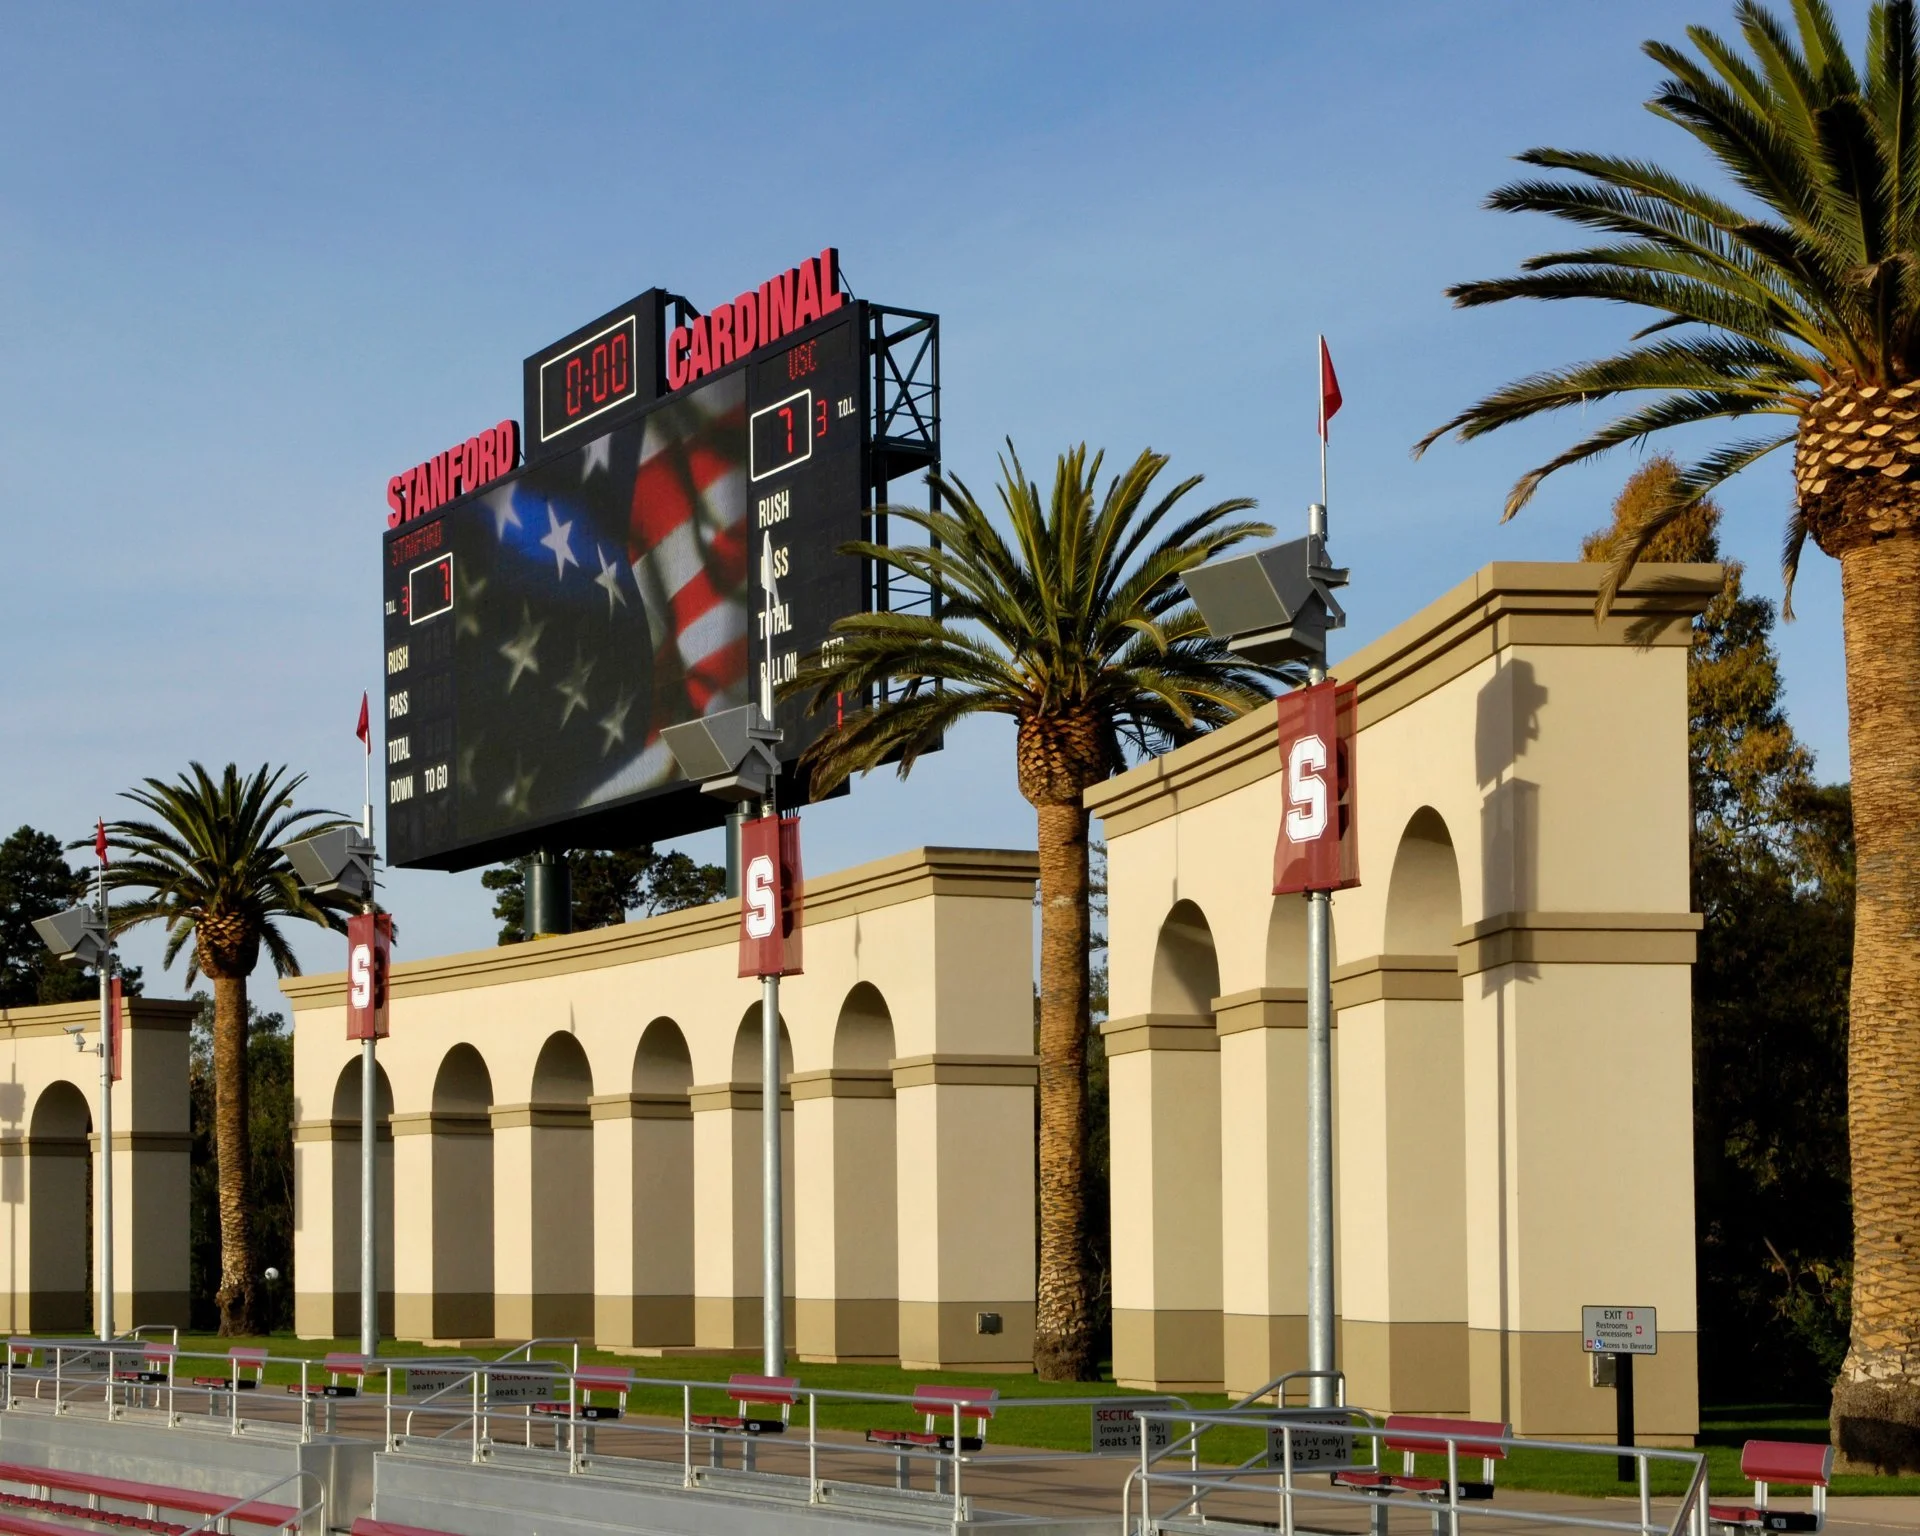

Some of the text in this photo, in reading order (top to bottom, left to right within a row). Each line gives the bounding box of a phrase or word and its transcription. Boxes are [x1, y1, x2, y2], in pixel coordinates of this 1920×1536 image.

[668, 247, 845, 392] CARDINAL
[567, 333, 627, 416] 0:00
[789, 341, 816, 380] USC
[778, 407, 792, 454] 7
[816, 400, 826, 438] 3
[387, 419, 517, 529] STANFORD
[759, 490, 790, 528] RUSH
[439, 562, 449, 600] 7
[402, 586, 409, 616] 3
[758, 603, 792, 640] TOTAL
[388, 646, 409, 675] RUSH
[760, 651, 797, 686] BLL ON
[389, 691, 408, 719] PASS
[388, 736, 410, 765] TOTAL
[390, 775, 413, 804] DOWN
[424, 764, 448, 793] TO GO
[1286, 734, 1327, 843] S
[746, 855, 775, 939] S
[352, 944, 371, 1009] S
[1595, 1321, 1628, 1329] Restrooms
[1604, 1310, 1622, 1320] EXIT
[1596, 1330, 1632, 1338] Concessions
[1630, 1342, 1653, 1350] Elevator
[437, 1381, 445, 1389] 11
[521, 1388, 526, 1396] 1
[536, 1387, 547, 1395] 22
[1096, 1410, 1143, 1421] SECTIO
[1100, 1423, 1125, 1434] (rows
[1147, 1423, 1164, 1433] nly)
[1099, 1437, 1127, 1447] seats
[1155, 1434, 1166, 1445] 21
[1274, 1452, 1303, 1461] sets
[1307, 1449, 1320, 1460] 23
[1334, 1449, 1346, 1459] 41
[1275, 1436, 1344, 1448] (rws J-V only)
